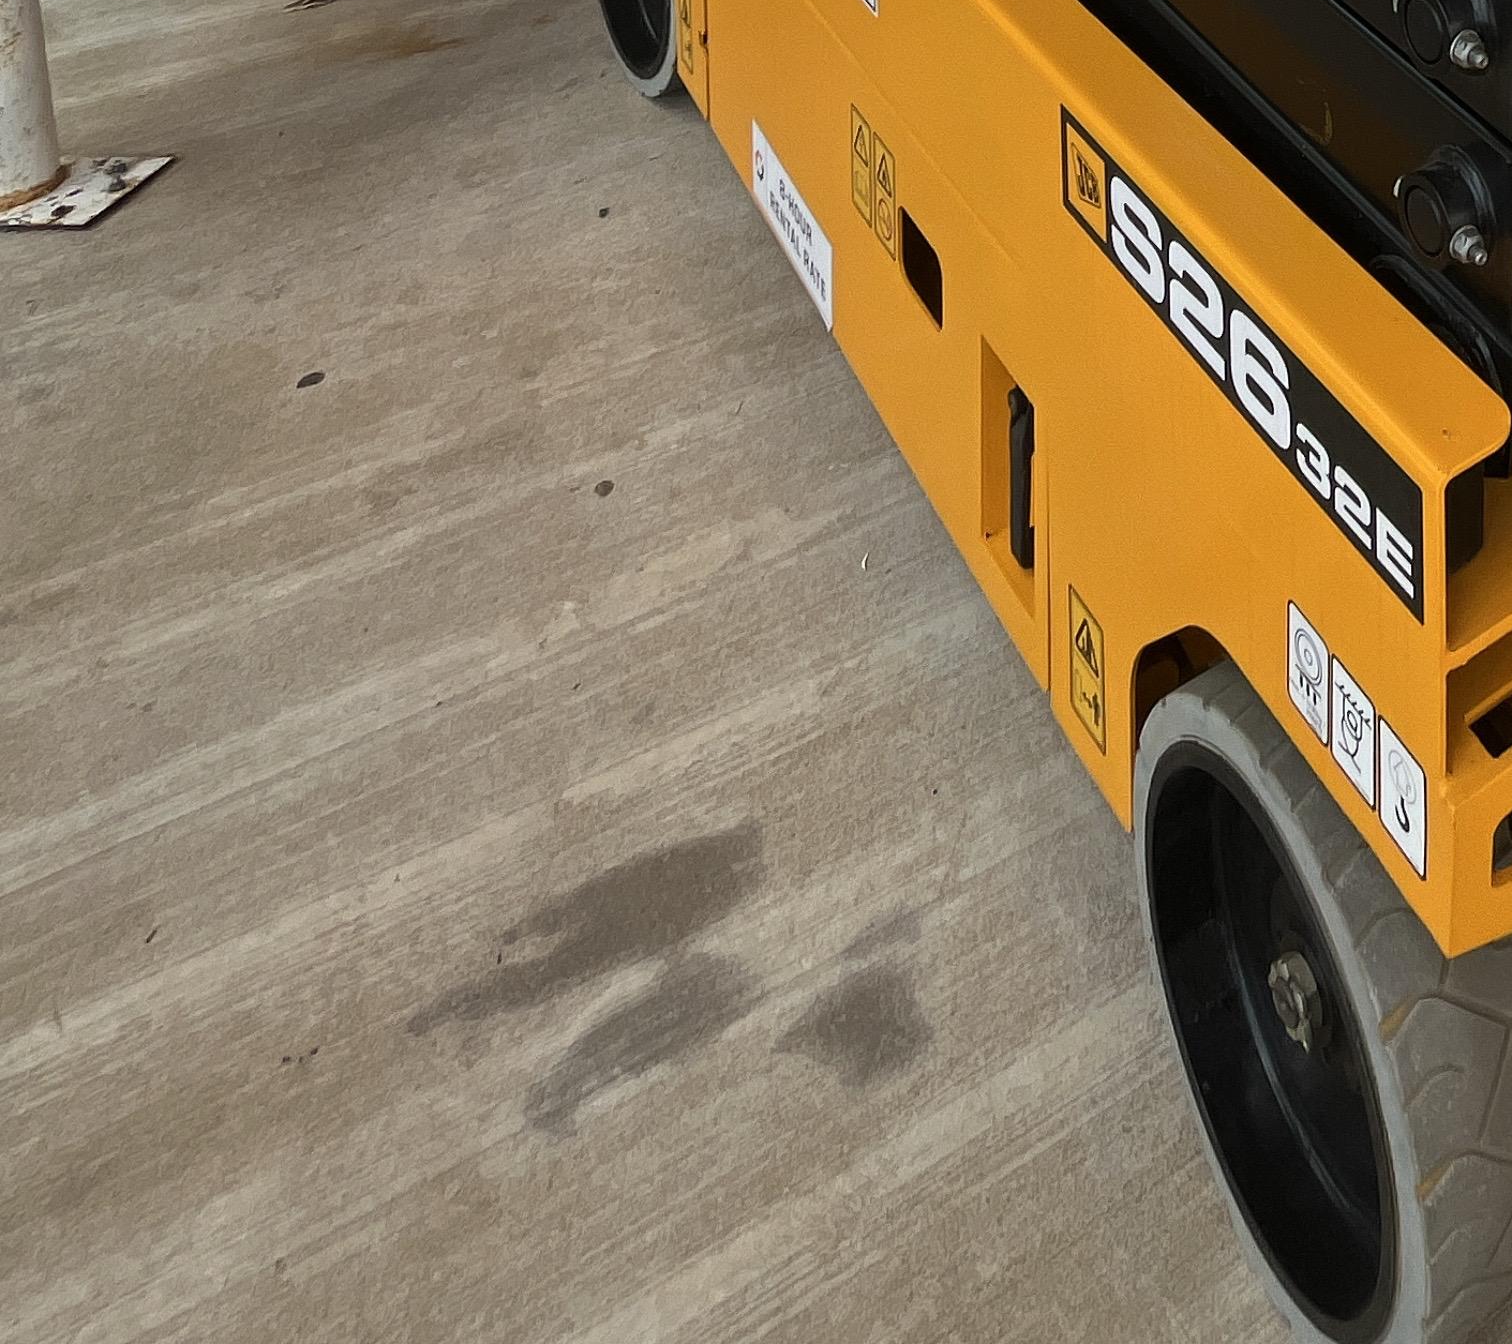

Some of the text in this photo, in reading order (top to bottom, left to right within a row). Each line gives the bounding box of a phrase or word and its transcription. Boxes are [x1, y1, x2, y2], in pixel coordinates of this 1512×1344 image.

[769, 189, 828, 302] RENTAL RATE
[1109, 174, 1416, 600] S26 32E
